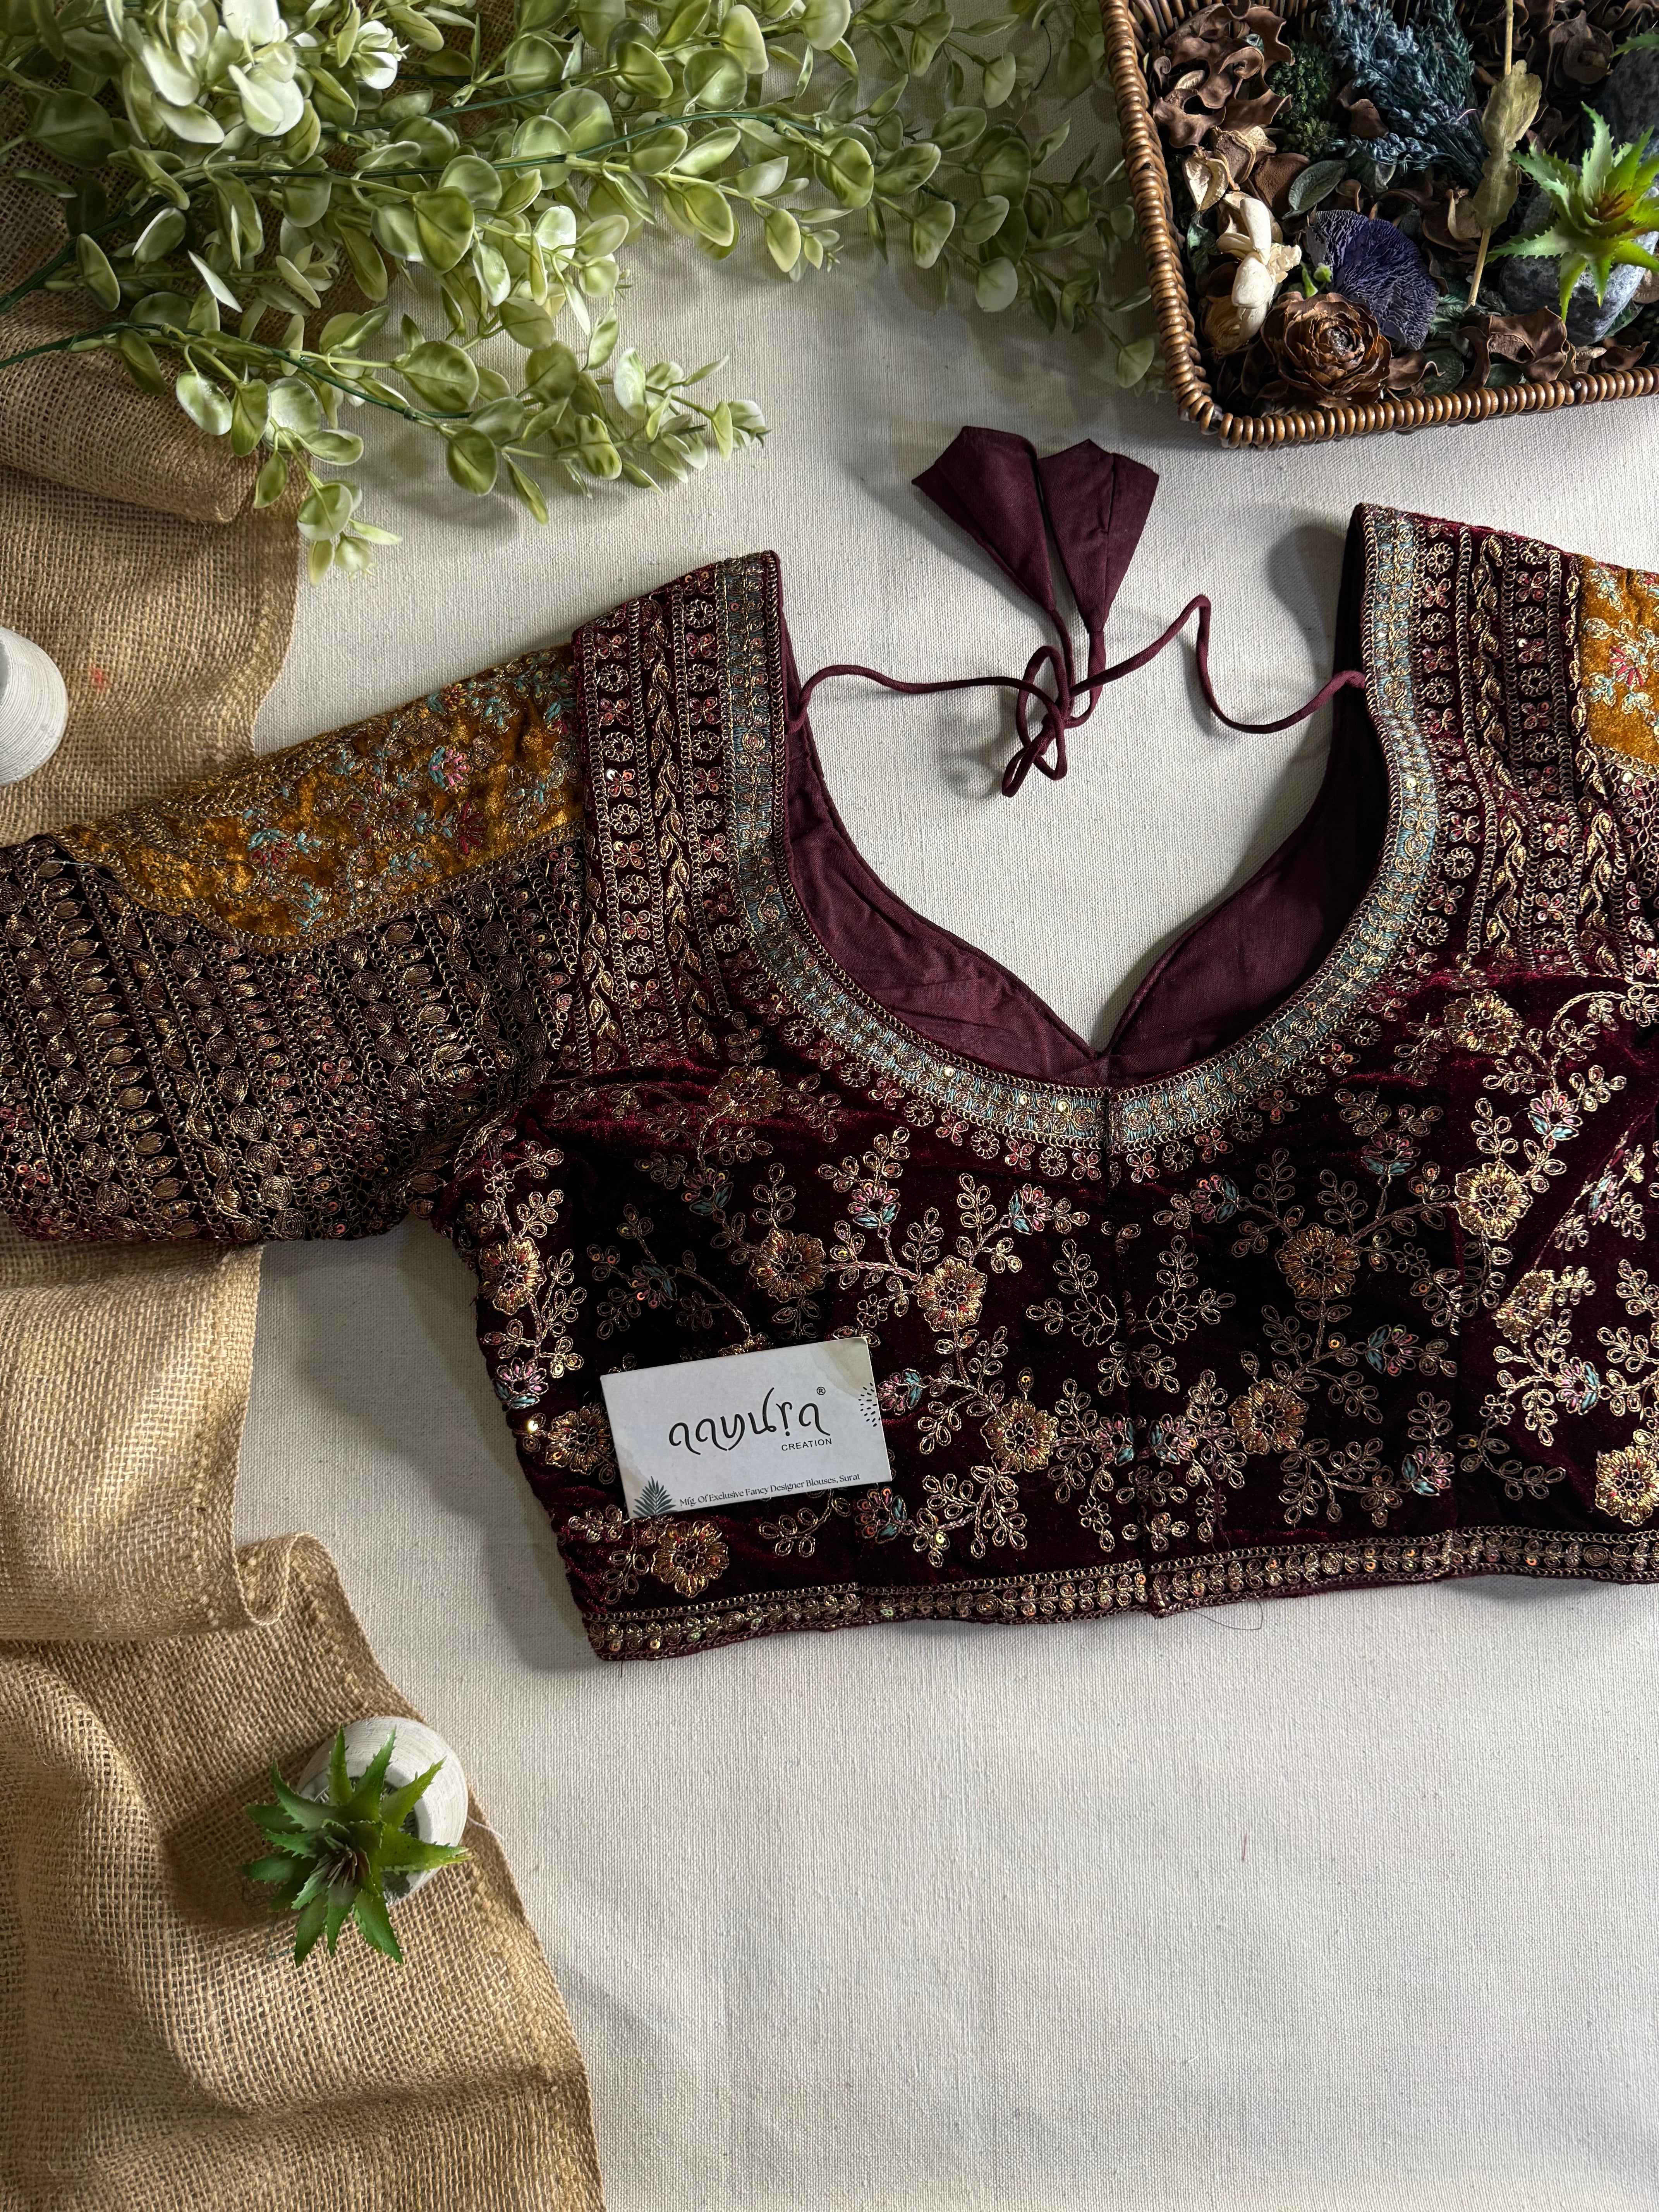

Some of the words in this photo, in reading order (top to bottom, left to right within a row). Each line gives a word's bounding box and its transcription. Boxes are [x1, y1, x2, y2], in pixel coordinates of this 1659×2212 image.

[781, 1438, 832, 1451] CREATION
[680, 1497, 696, 1506] Mfg.
[698, 1495, 708, 1503] Of
[709, 1491, 744, 1501] Exclusive
[745, 1487, 769, 1496] Fancy
[770, 1482, 804, 1492] Designer
[806, 1477, 838, 1487] Blouses,
[839, 1474, 860, 1482] Surat
